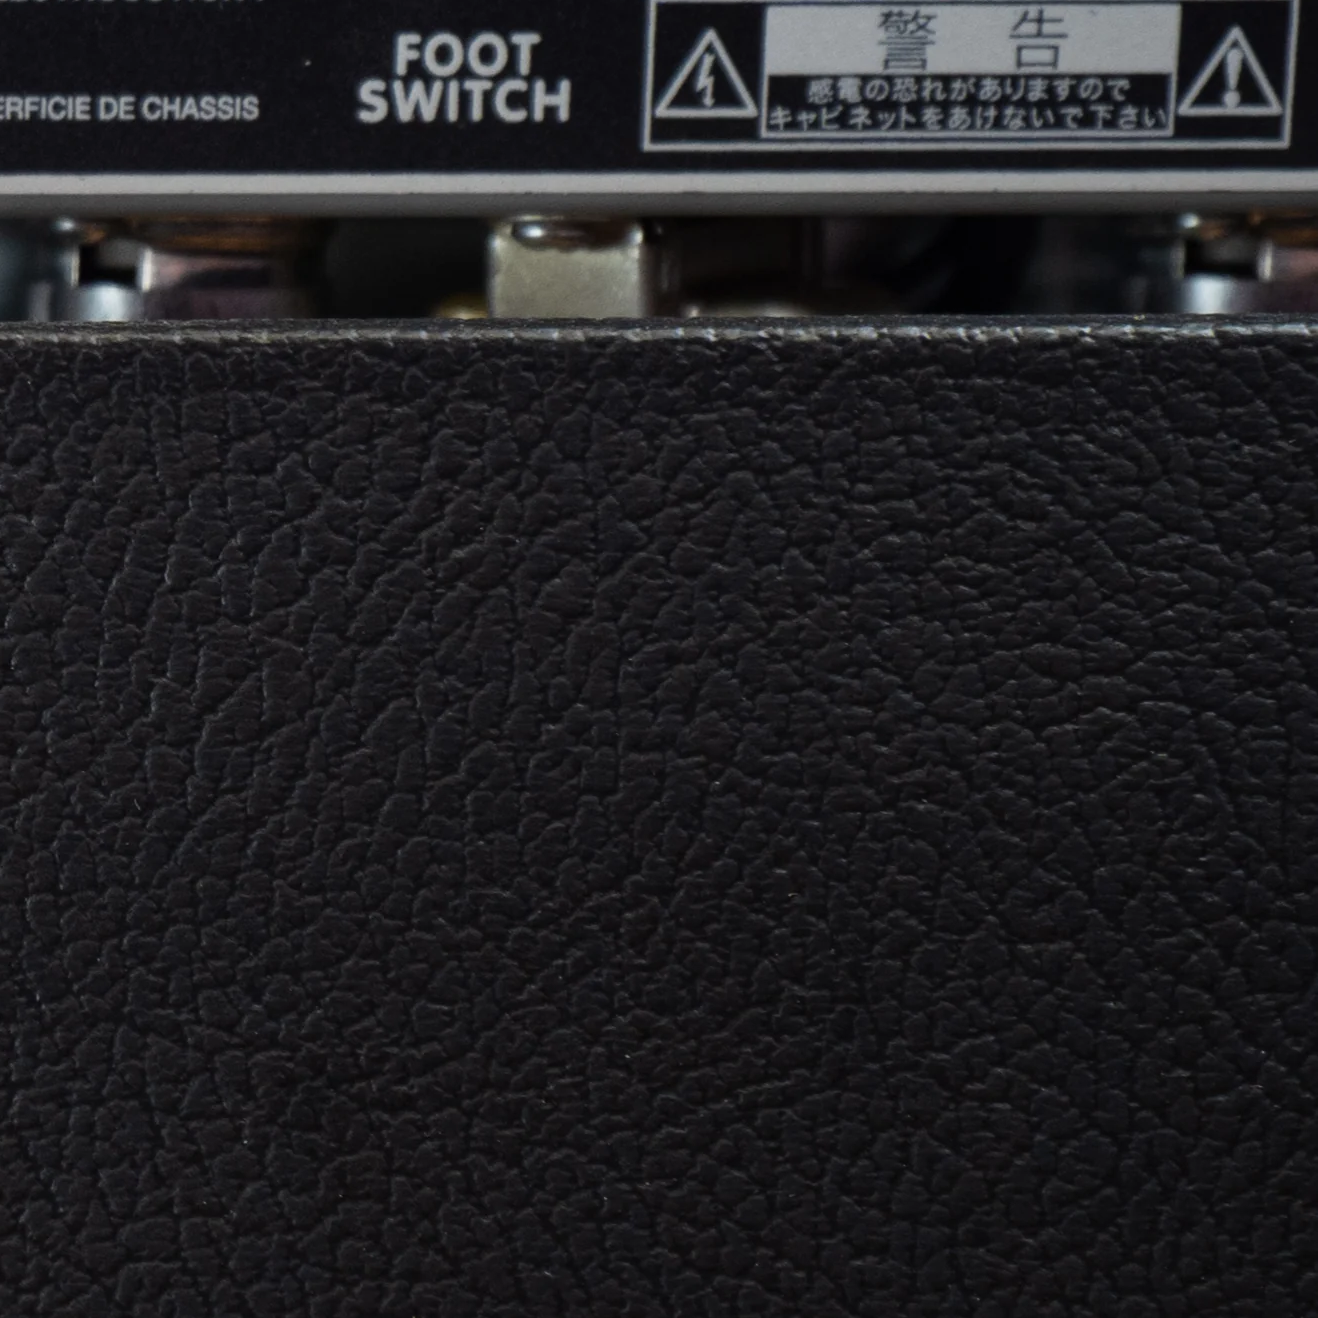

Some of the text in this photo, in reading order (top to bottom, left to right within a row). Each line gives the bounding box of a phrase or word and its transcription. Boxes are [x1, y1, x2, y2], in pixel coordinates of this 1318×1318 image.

[394, 32, 541, 78] FOOT
[98, 95, 136, 121] DE
[140, 95, 260, 121] CHASSIS
[357, 78, 571, 124] SWITCH
